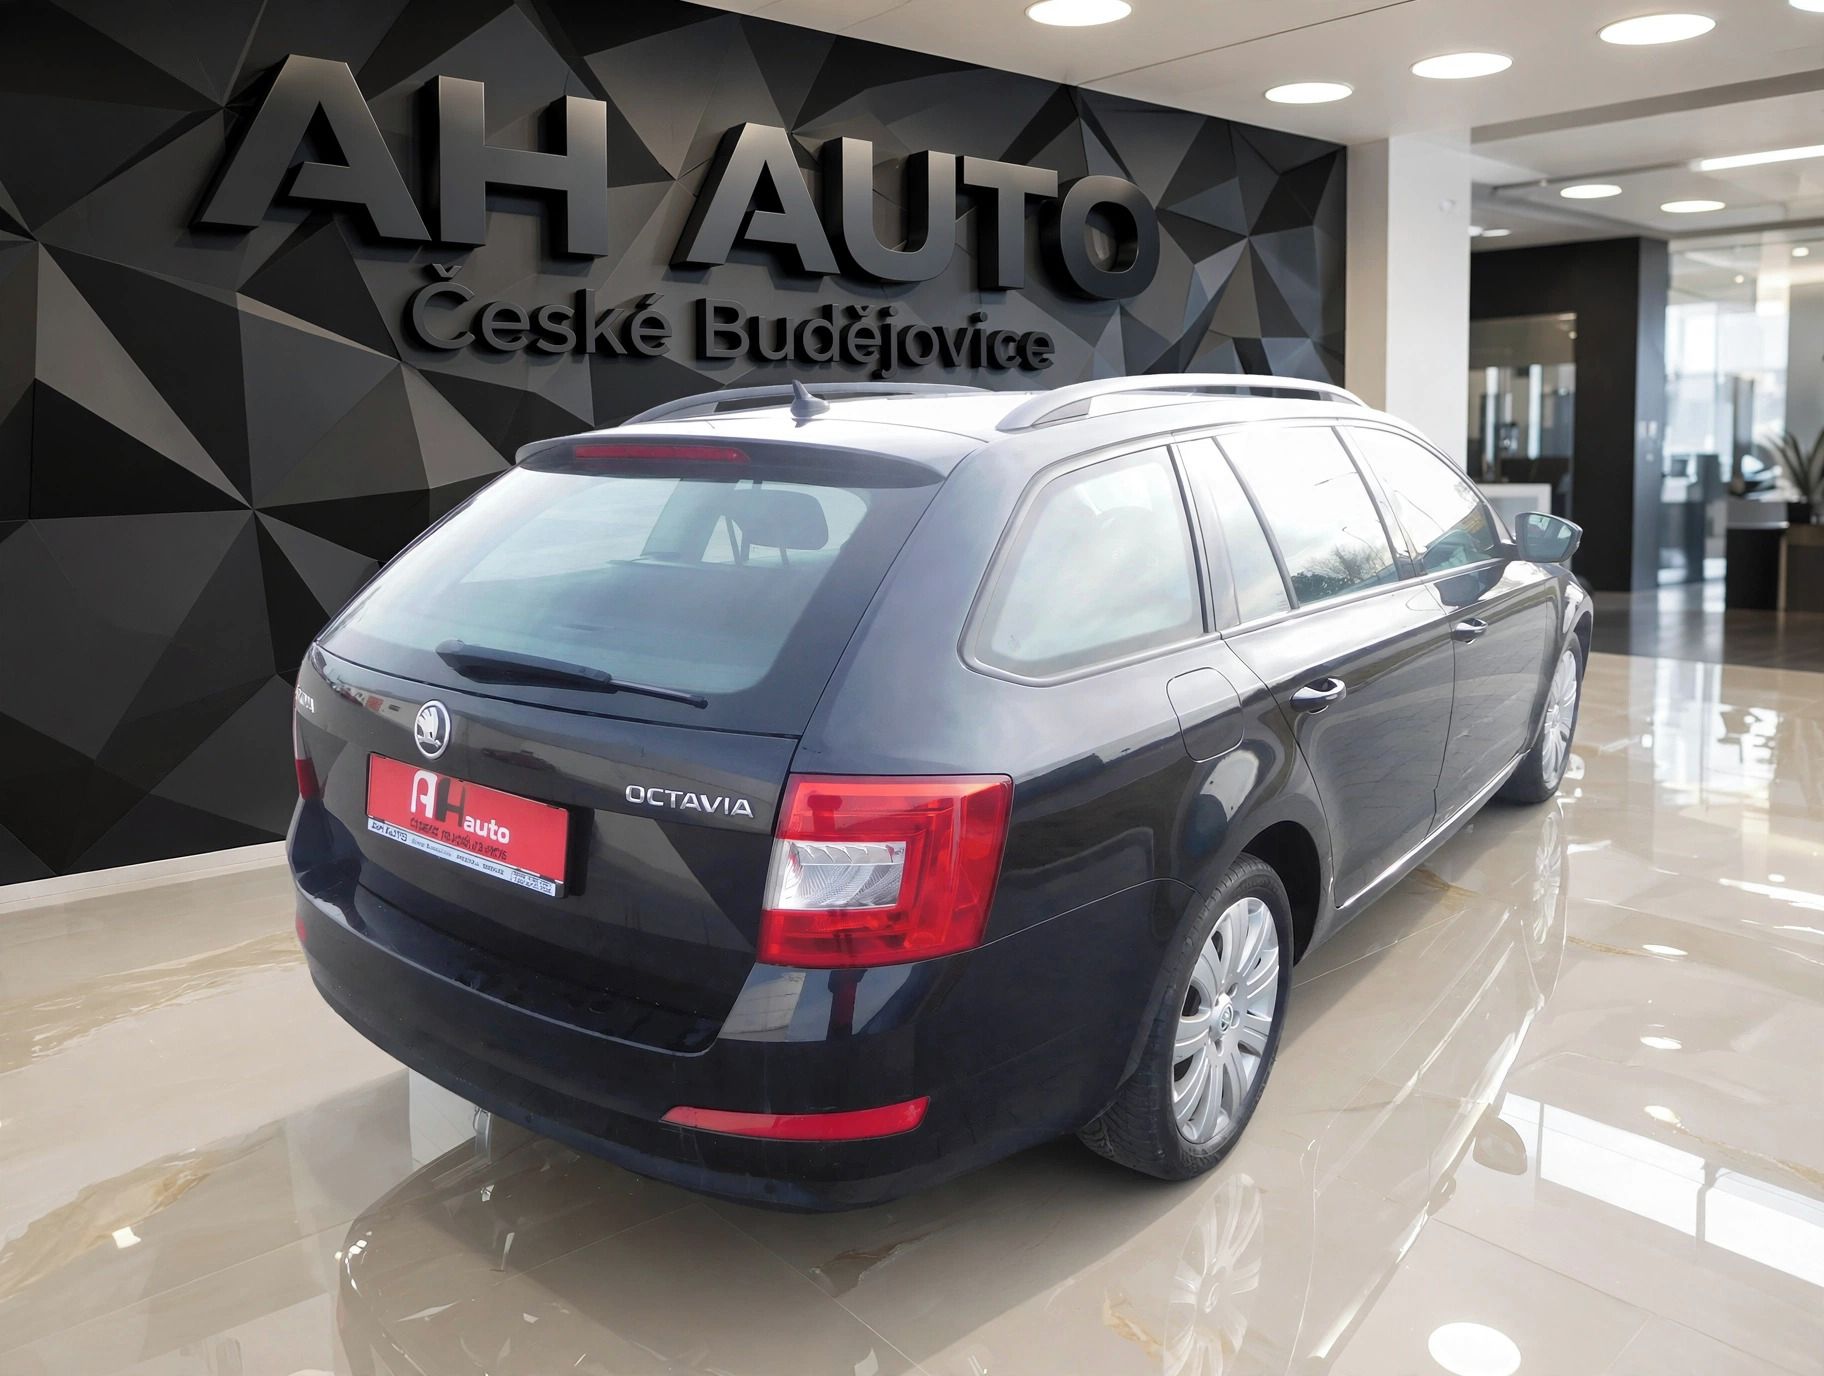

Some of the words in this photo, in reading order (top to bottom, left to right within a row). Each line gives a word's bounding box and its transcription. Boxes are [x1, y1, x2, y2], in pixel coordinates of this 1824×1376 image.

[194, 54, 609, 258] AH
[676, 122, 1160, 301] AUTO
[406, 263, 673, 359] České
[698, 299, 1056, 379] Budějovice
[624, 784, 755, 818] OCTAVIA
